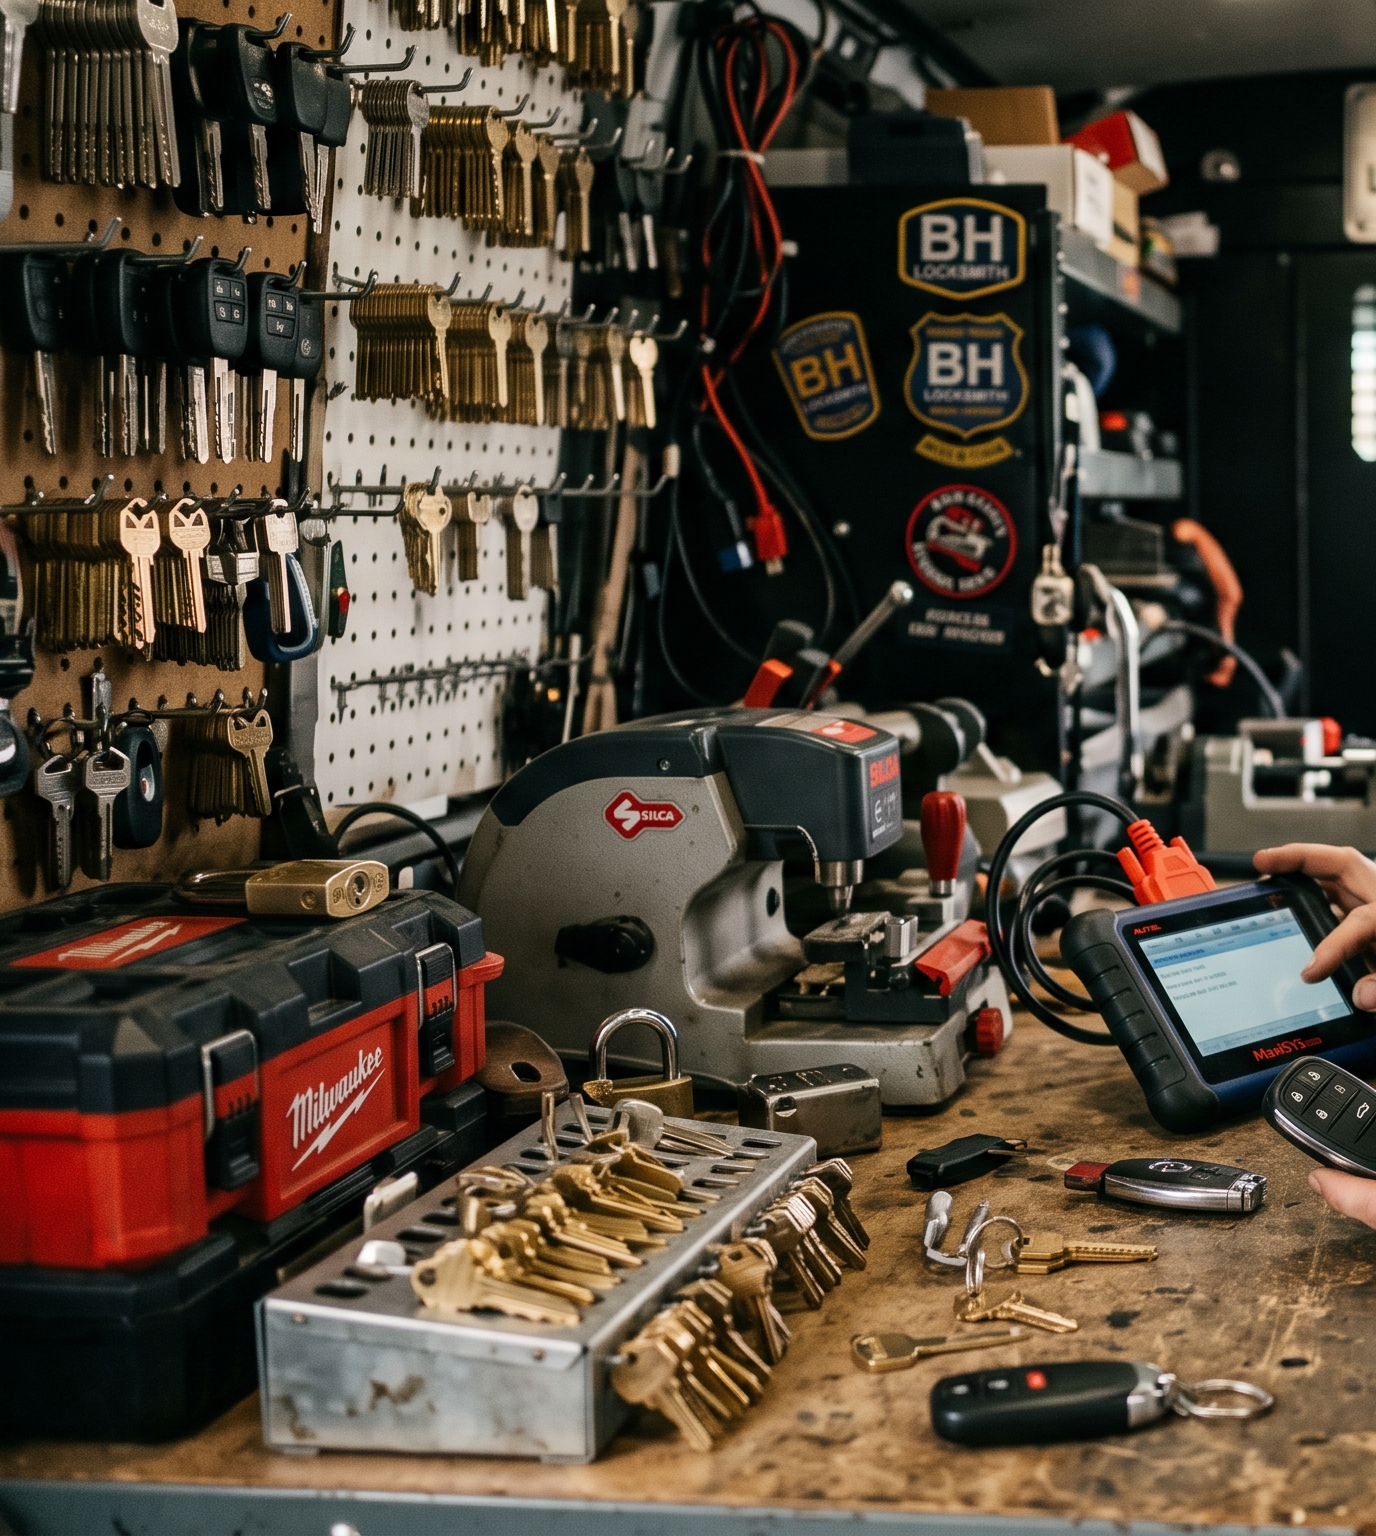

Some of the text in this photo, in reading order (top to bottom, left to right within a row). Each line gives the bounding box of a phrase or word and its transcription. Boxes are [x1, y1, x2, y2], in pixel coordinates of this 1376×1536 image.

[920, 214, 1003, 262] BH
[912, 264, 1010, 280] LOCKSMITH
[791, 343, 862, 398] BH
[927, 341, 1003, 386] BH
[923, 388, 1010, 402] LOCKSMITH
[641, 810, 675, 821] SILCA
[285, 1046, 385, 1150] Milwaukee
